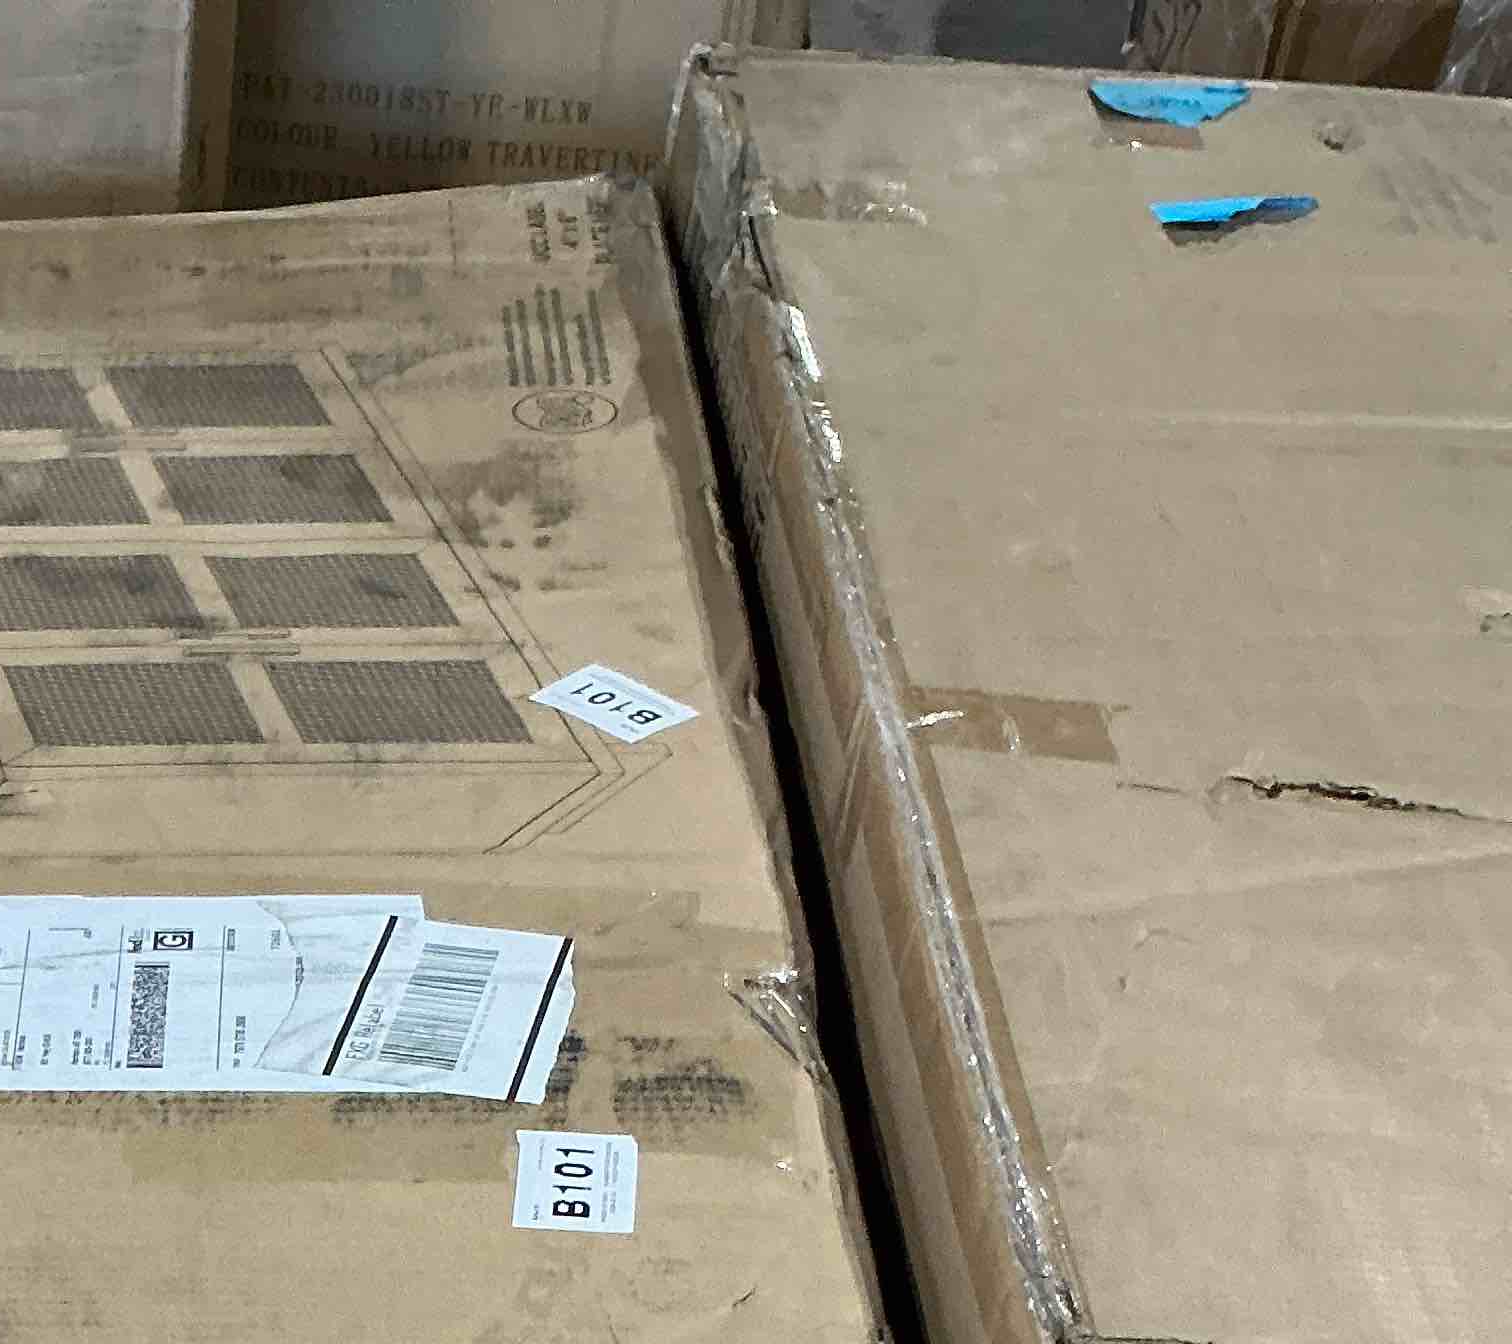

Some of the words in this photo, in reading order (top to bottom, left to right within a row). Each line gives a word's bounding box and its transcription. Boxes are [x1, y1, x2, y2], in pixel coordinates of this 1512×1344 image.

[570, 682, 662, 725] B101
[160, 934, 186, 948] G
[552, 1147, 595, 1218] B101
